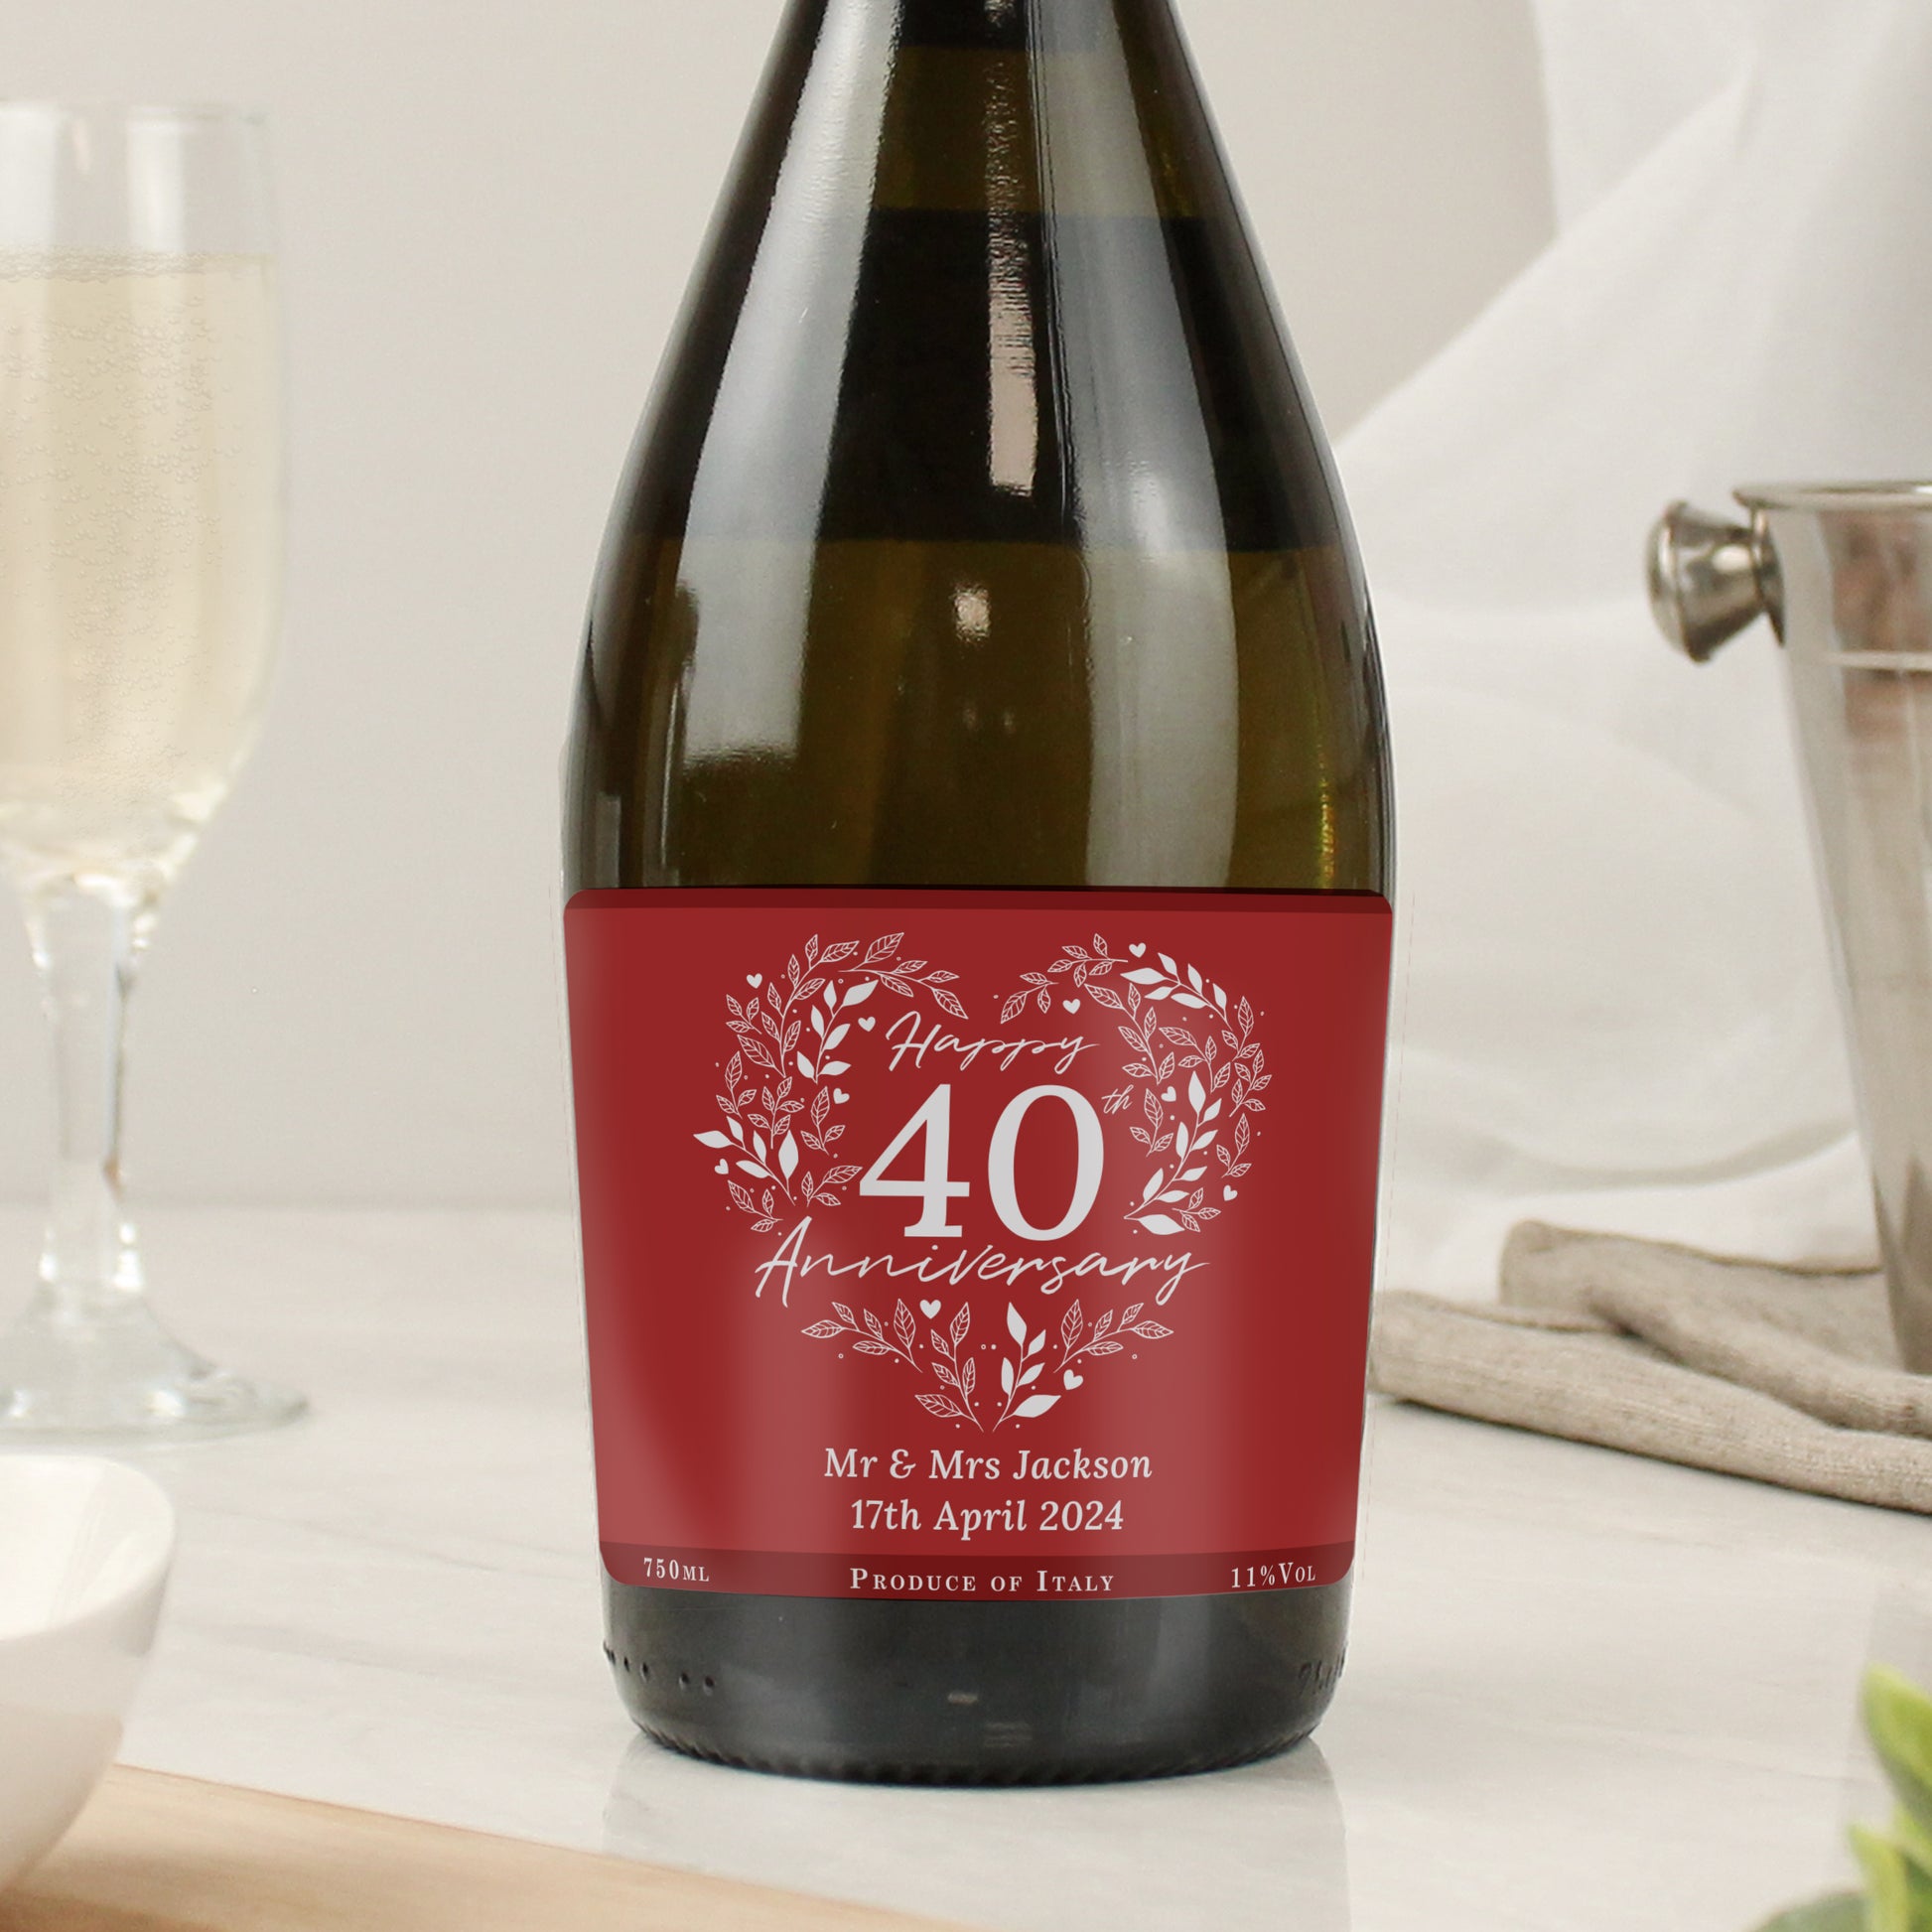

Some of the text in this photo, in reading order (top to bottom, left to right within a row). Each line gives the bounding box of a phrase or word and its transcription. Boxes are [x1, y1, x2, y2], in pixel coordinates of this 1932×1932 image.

[885, 1010, 1100, 1075] Happy
[755, 1215, 1210, 1308] Anniversary
[823, 1448, 1153, 1480] Mr & Mrs Jackson
[851, 1498, 1124, 1541] 17th April 2024
